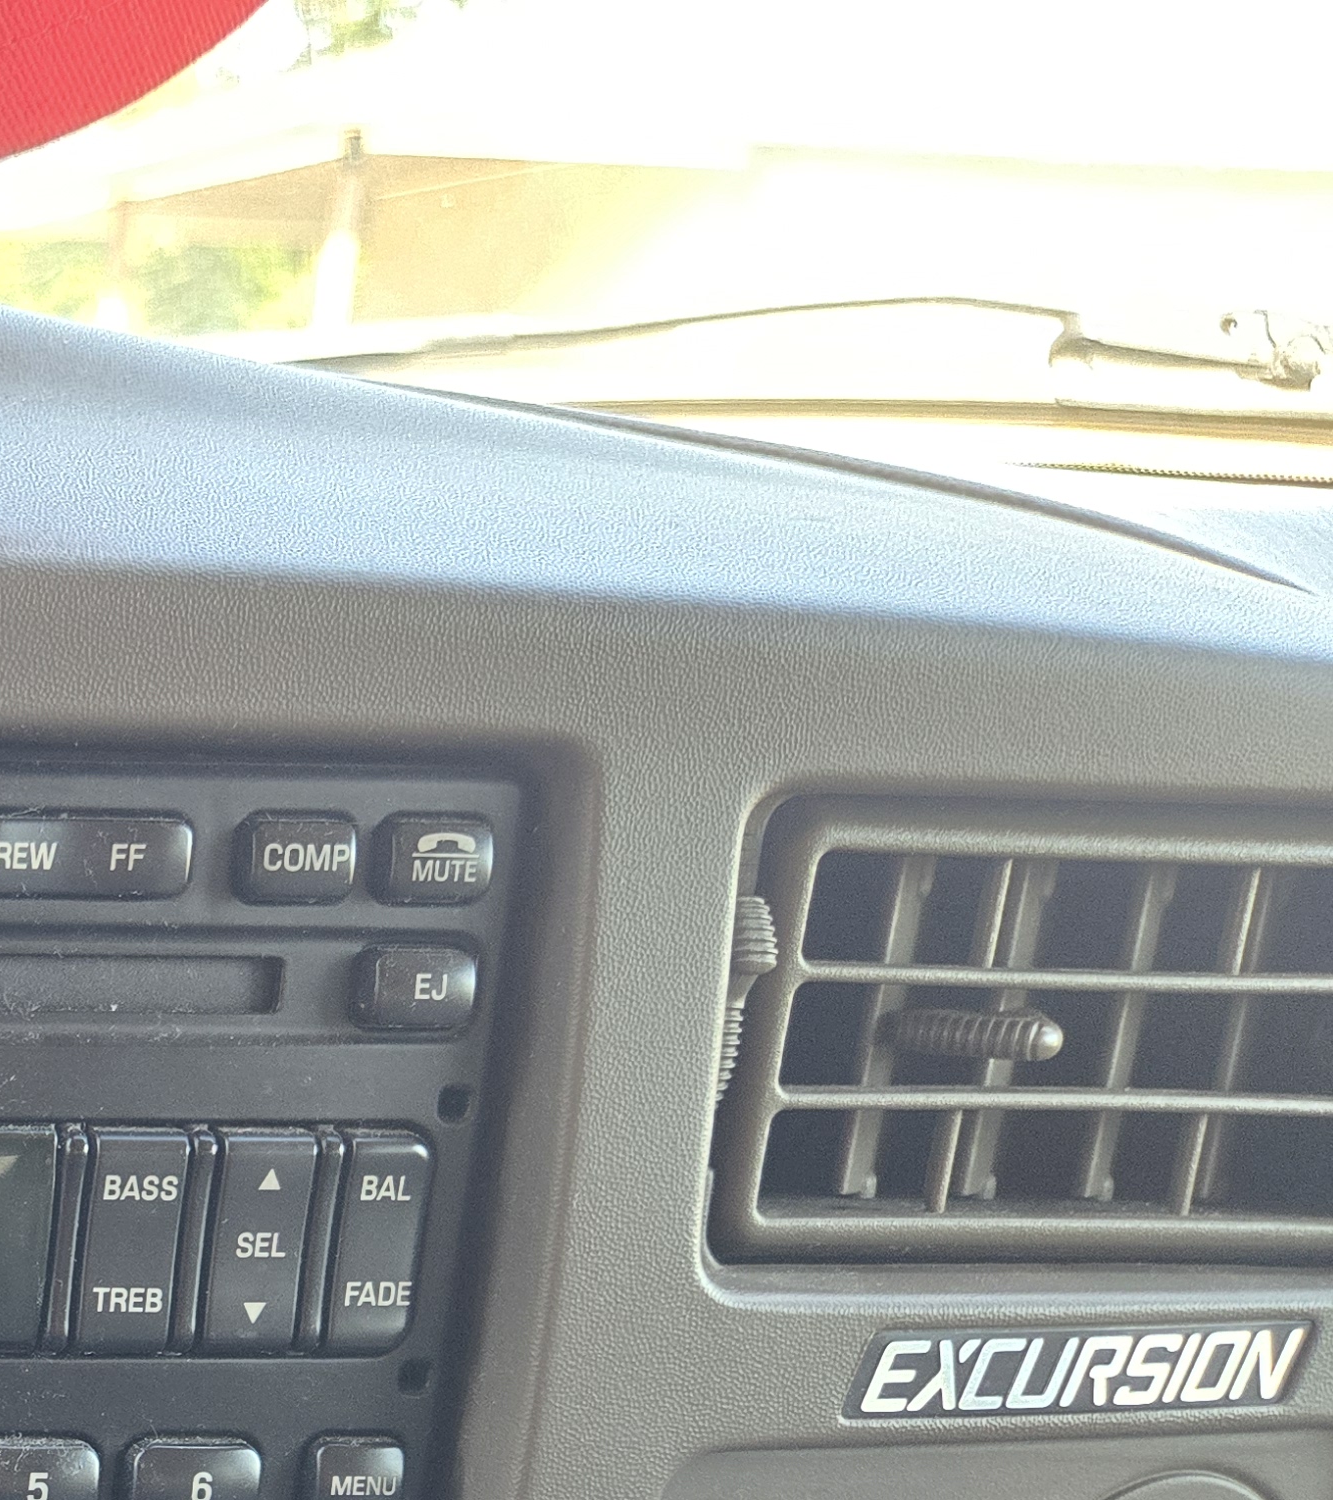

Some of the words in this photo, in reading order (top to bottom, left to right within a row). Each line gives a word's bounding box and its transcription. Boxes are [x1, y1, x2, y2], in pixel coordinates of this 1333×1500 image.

[108, 842, 148, 873] FF
[261, 842, 351, 874] COMP
[410, 858, 479, 884] MUTE
[412, 972, 449, 1002] EJ
[101, 1174, 179, 1202] BASS
[359, 1174, 413, 1203] BAL
[235, 1231, 287, 1259] SEL
[91, 1286, 165, 1314] TREB
[343, 1280, 412, 1308] FADE
[859, 1326, 1307, 1415] EXCURSION
[330, 1473, 397, 1498] MENU
